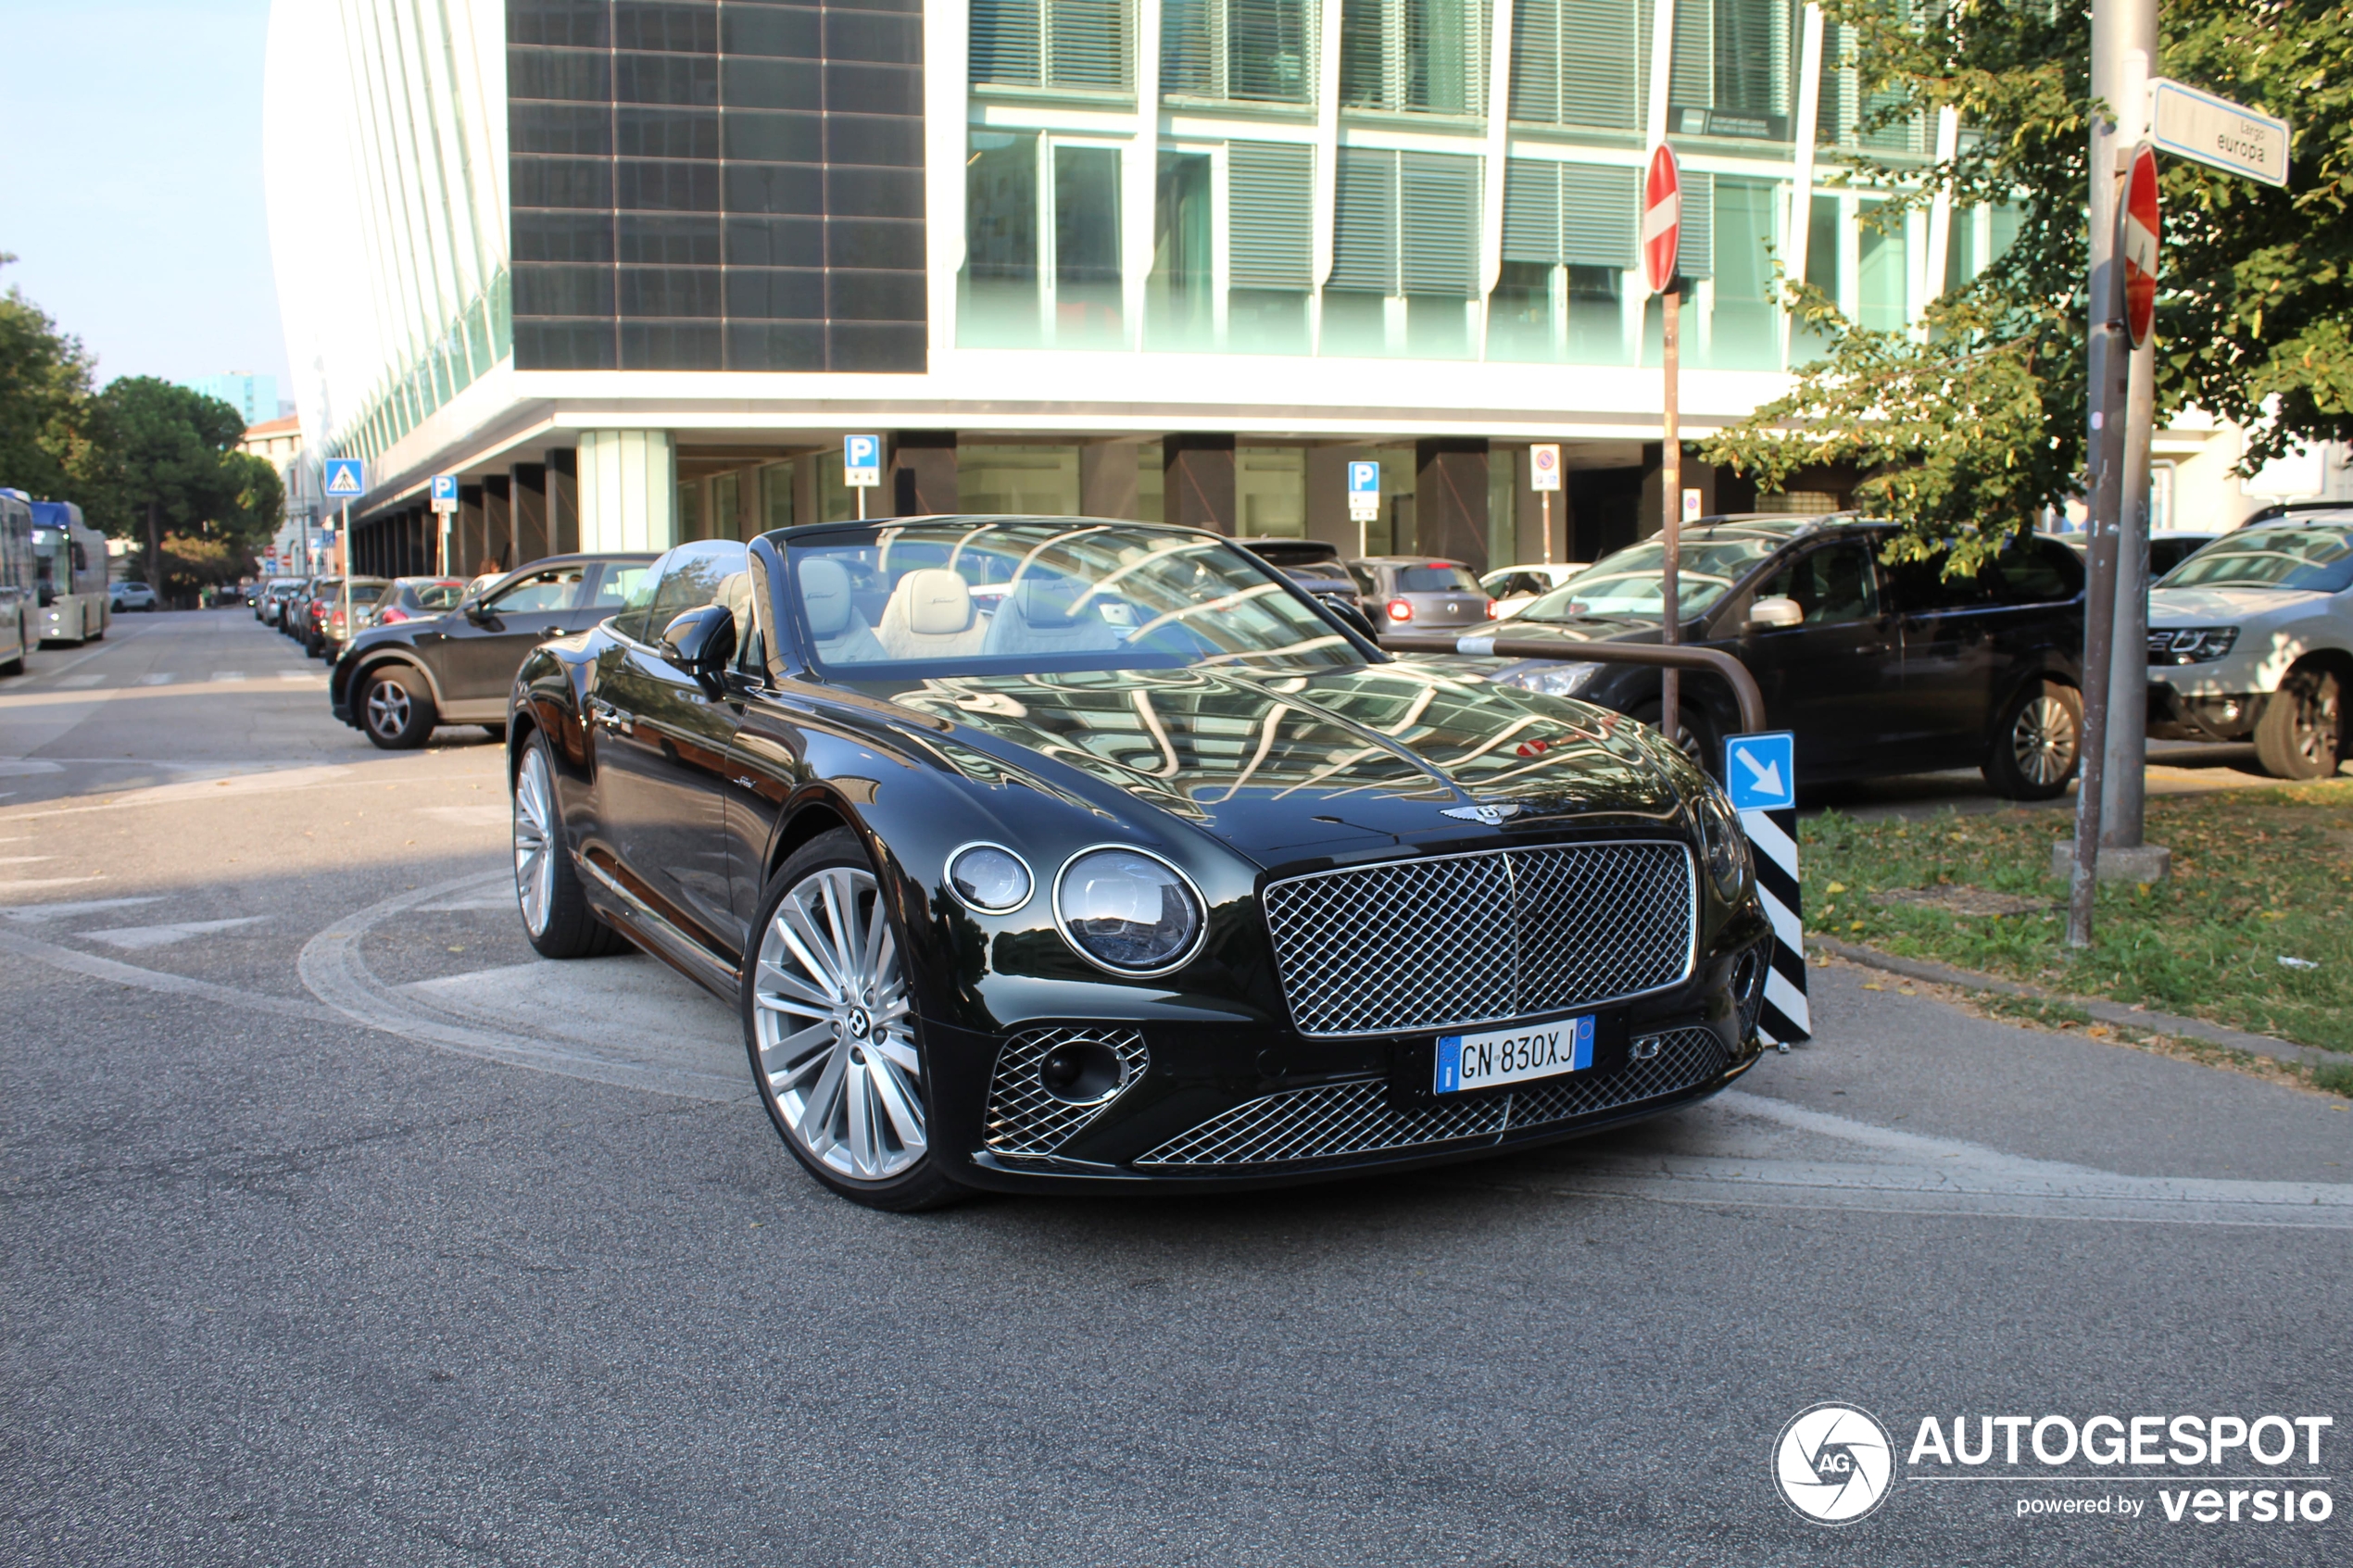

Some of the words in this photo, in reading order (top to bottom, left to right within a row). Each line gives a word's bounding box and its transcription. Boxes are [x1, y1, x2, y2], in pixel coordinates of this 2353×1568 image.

[2217, 134, 2264, 163] europa
[849, 437, 873, 466] P
[435, 477, 451, 497] P
[1353, 464, 1374, 490] P
[1462, 1042, 1492, 1078] GN
[1501, 1029, 1574, 1073] 830XJ
